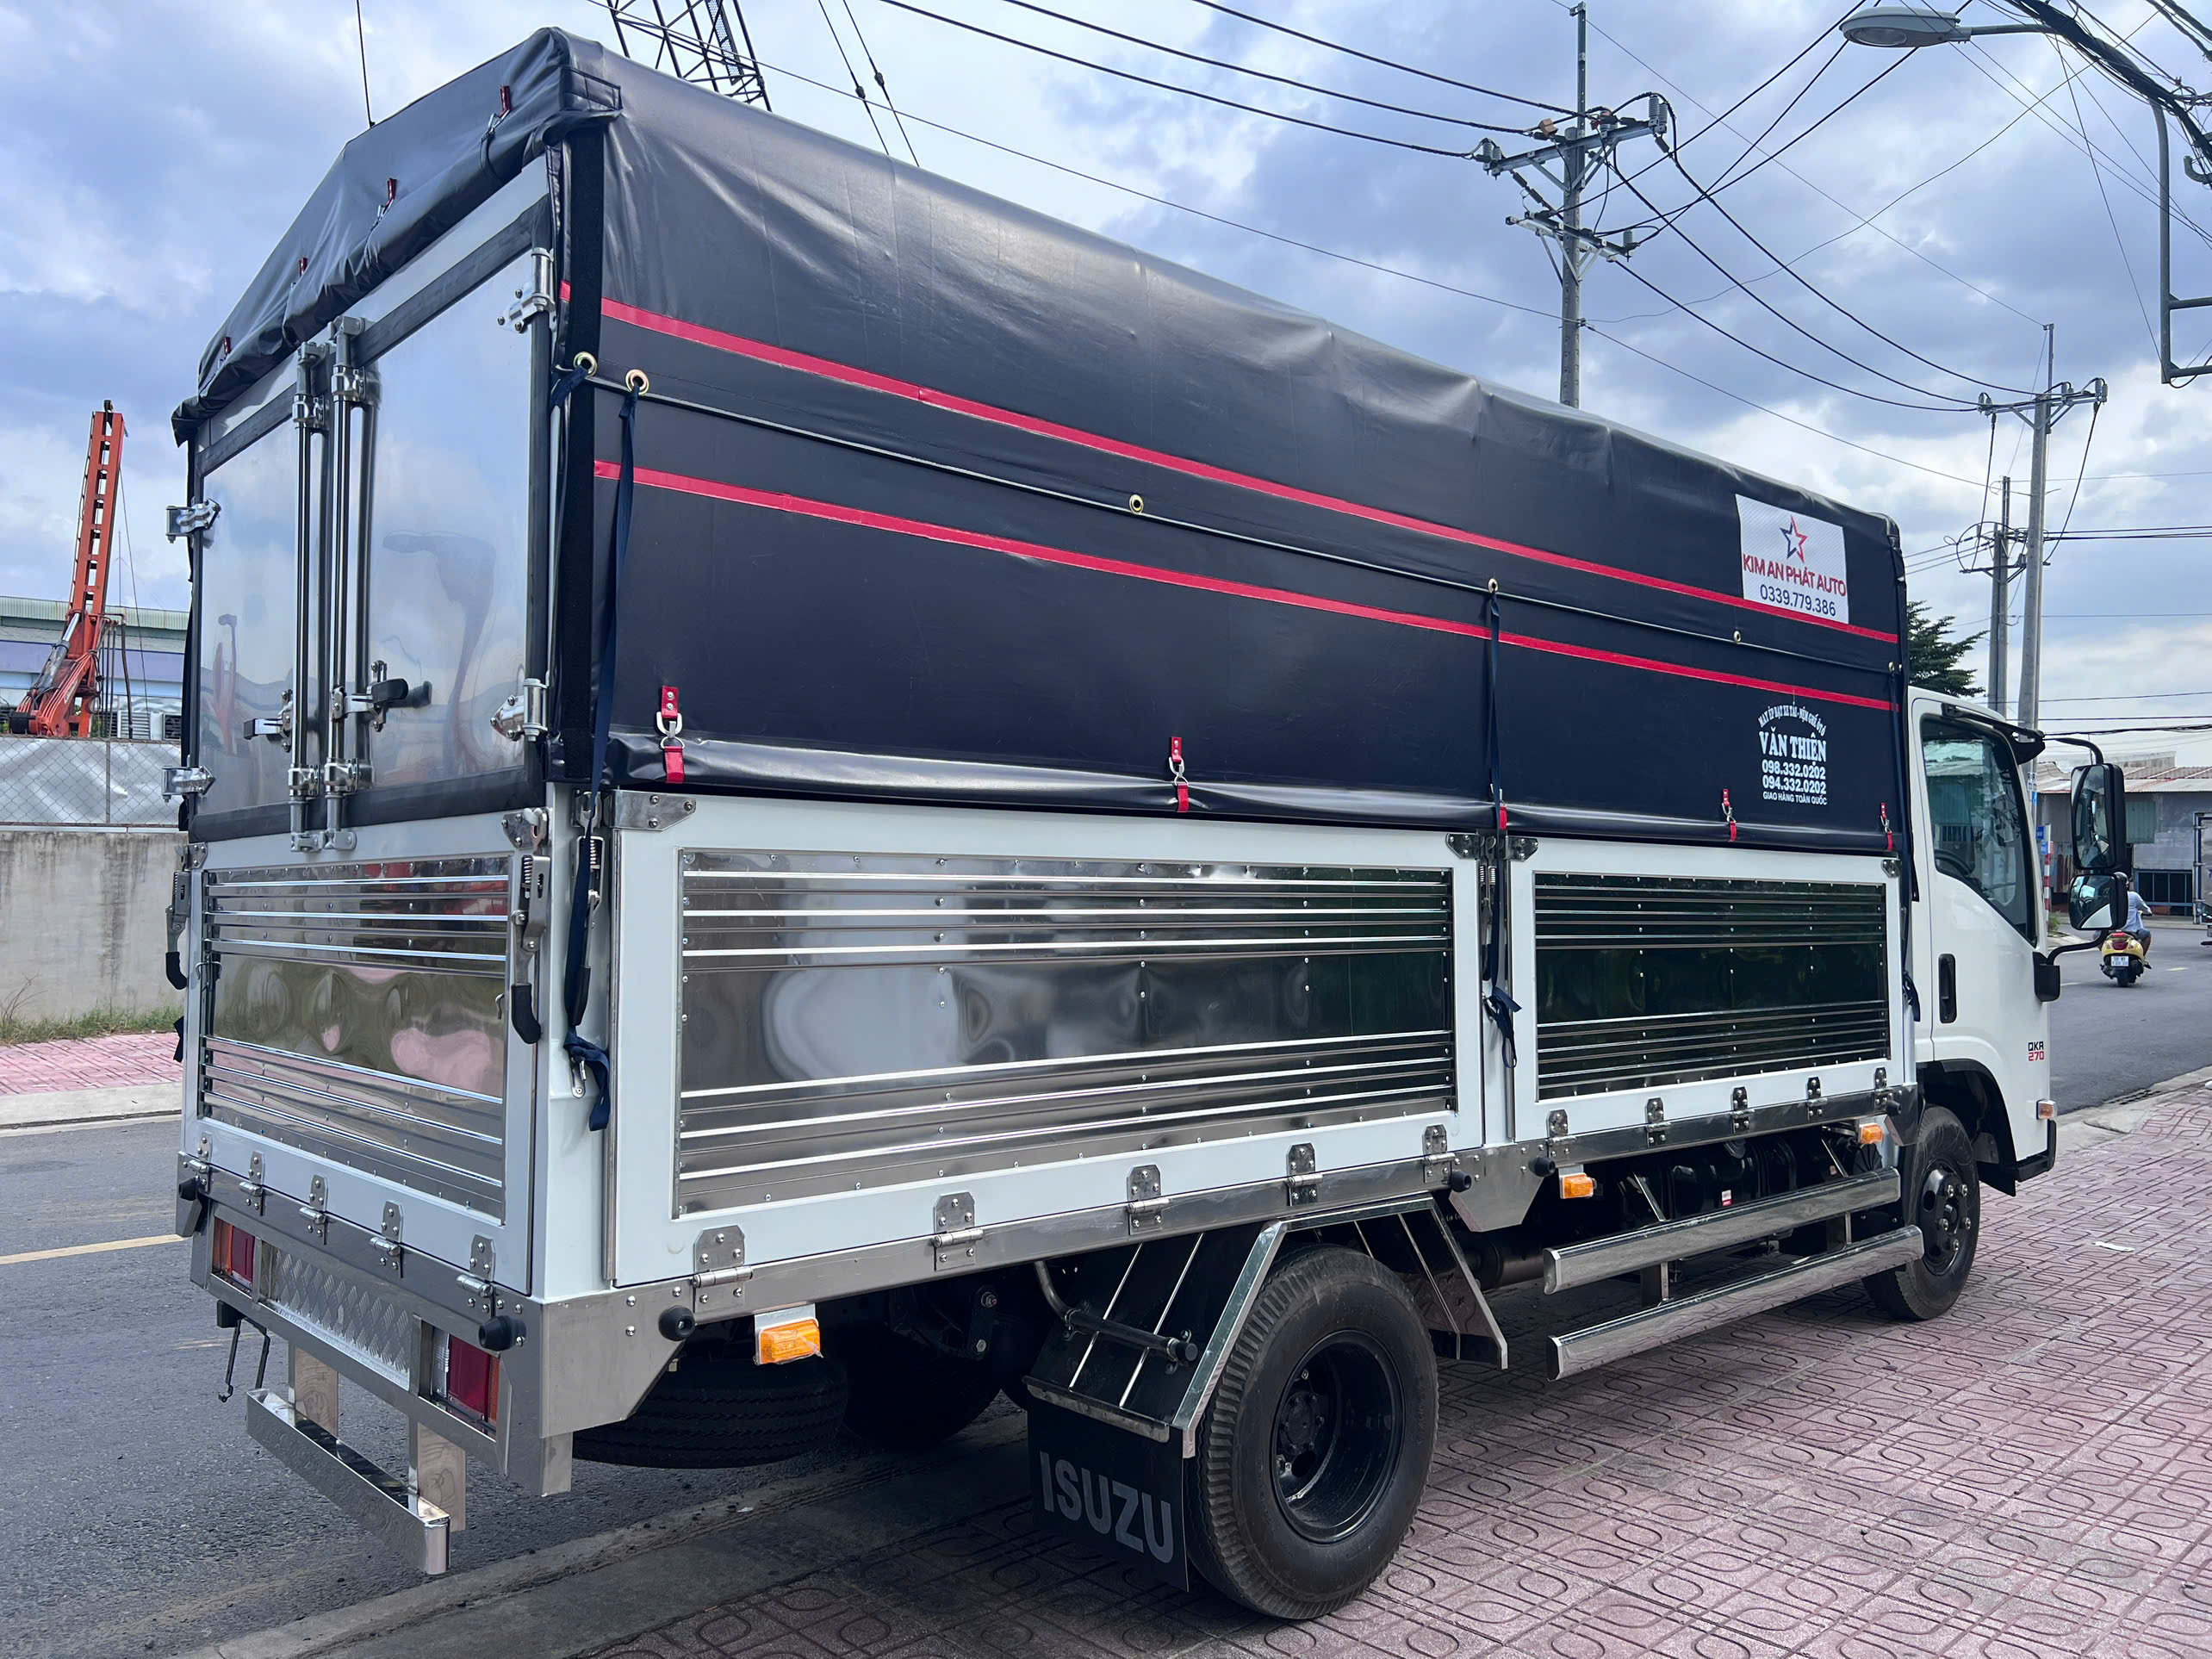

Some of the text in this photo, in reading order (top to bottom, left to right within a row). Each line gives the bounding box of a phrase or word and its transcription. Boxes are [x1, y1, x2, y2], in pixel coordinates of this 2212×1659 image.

[1743, 553, 1846, 596] KIM AN PHÁT AUTO
[1760, 584, 1836, 617] 0339.779.386
[1759, 726, 1826, 766] VĂN THIỆN
[1762, 759, 1826, 780] 098.332.0202
[1762, 774, 1826, 795] 094.332.0202
[1763, 791, 1827, 805] GIAO HÀNG TOÀN QUỐC
[2029, 1051, 2044, 1061] 270
[1040, 1451, 1174, 1563] ISUZU
